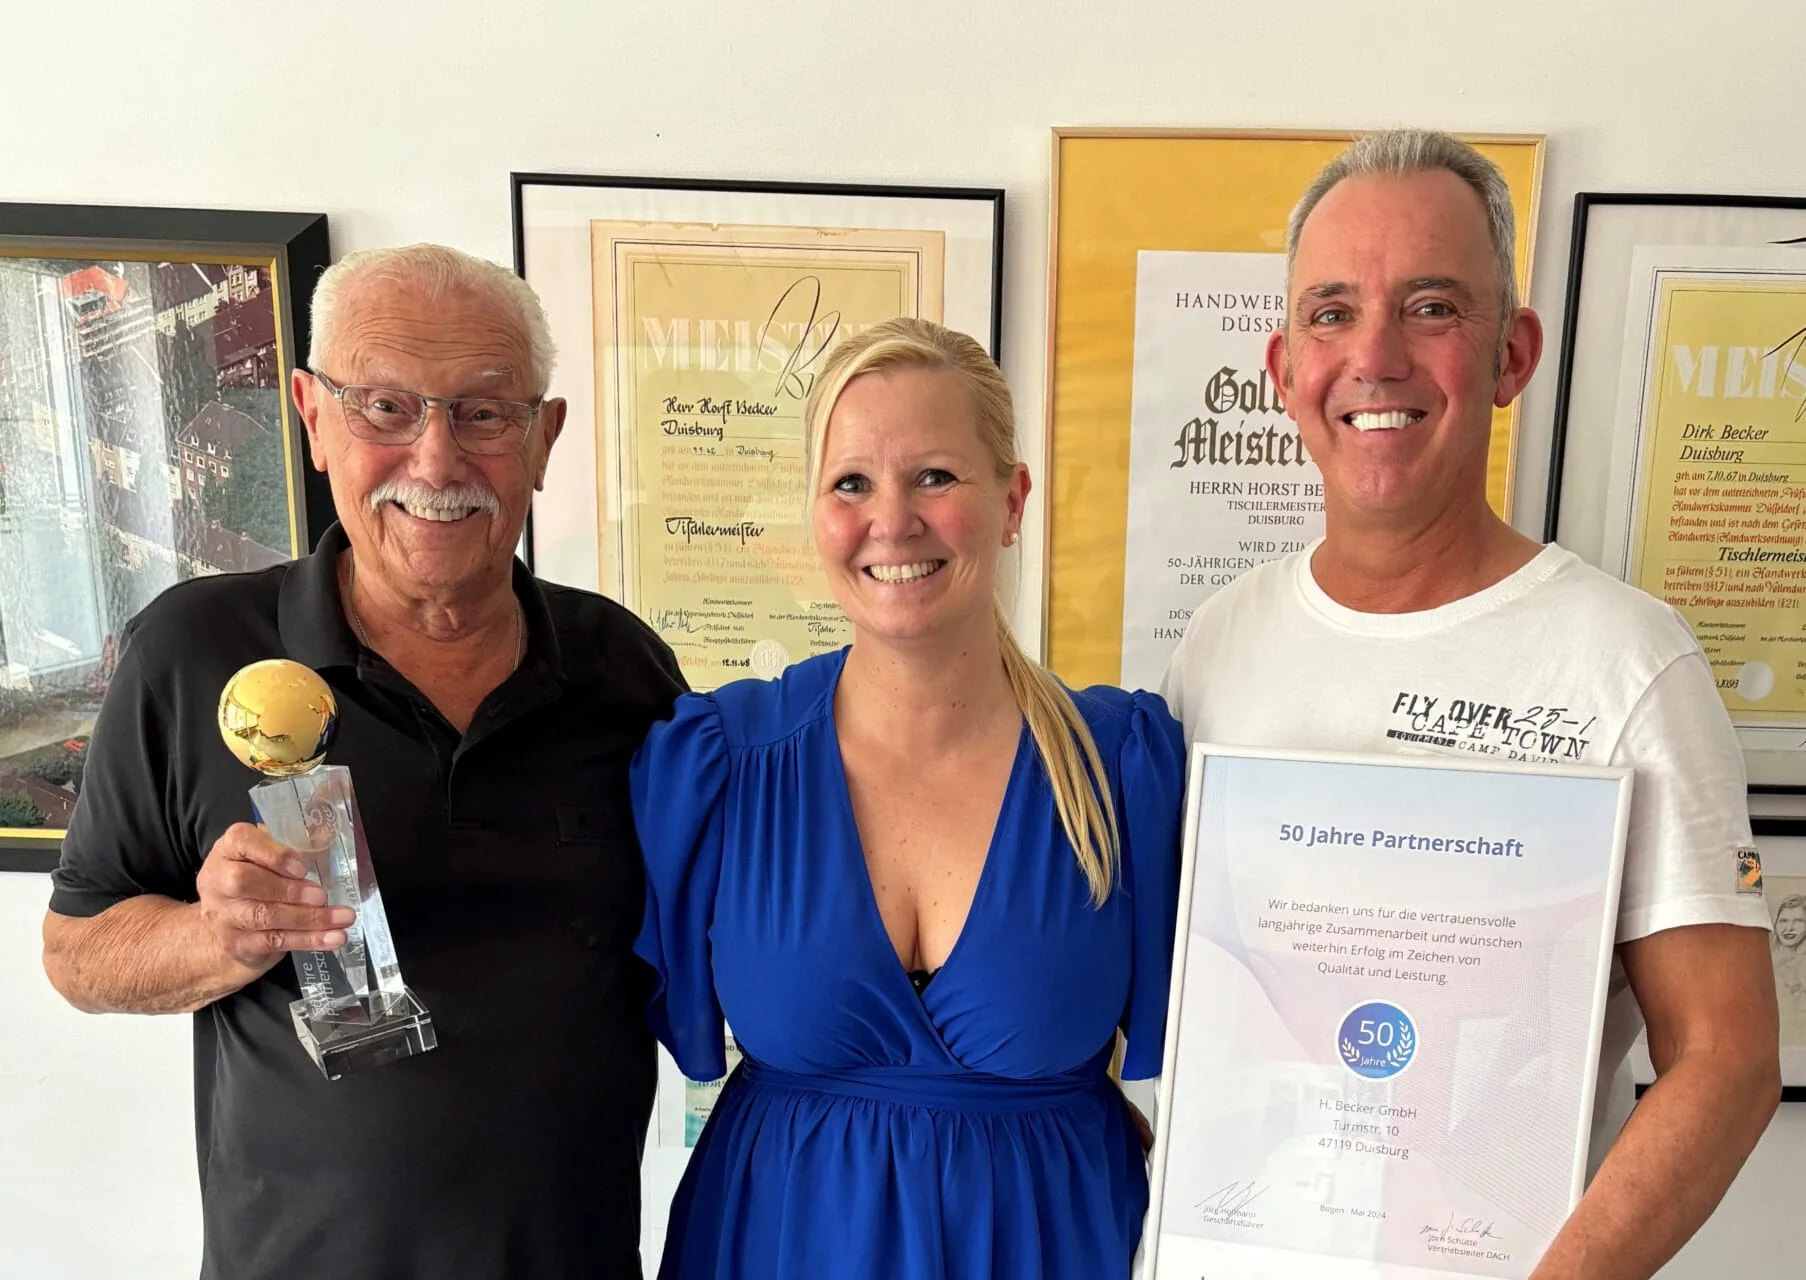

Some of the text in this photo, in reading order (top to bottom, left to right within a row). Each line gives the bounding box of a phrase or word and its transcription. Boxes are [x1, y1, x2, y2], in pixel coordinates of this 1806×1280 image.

[1176, 293, 1285, 310] HANDWER
[1222, 315, 1285, 332] DÜSSE
[641, 316, 858, 375] MEISTE
[1669, 344, 1806, 400] MEIS
[1682, 423, 1769, 441] Dirk Becker
[1170, 417, 1307, 470] Meister
[1680, 445, 1745, 464] Duisburg
[1748, 471, 1790, 483] Duisburg
[1190, 481, 1324, 497] HERRN HORST BE
[1248, 514, 1305, 526] DUISBURG
[1239, 541, 1276, 553] WIRD
[1718, 547, 1806, 562] Tischlermeis
[1167, 556, 1254, 569] 50-JÄHRIGEN
[1180, 574, 1237, 586] DER GO
[1736, 569, 1750, 578] ein
[1169, 608, 1195, 620] DÜS
[1154, 628, 1187, 639] HAN
[1392, 692, 1438, 718] FLY
[1449, 700, 1513, 731] OVER
[1458, 741, 1500, 755] CAMP
[1501, 726, 1590, 761] TOWN
[1279, 824, 1524, 857] 50 Jahre Partnerschaft
[1268, 898, 1288, 910] Wir
[1292, 900, 1349, 915] bedanken
[1353, 908, 1374, 917] uns
[1399, 908, 1417, 920] die
[1420, 911, 1517, 928] vertrauensvolle
[1326, 923, 1429, 941] Zusammenarbeit
[1432, 933, 1455, 943] und
[1459, 935, 1522, 949] wünschen
[1292, 941, 1481, 965] weiterhin Erfolg im Zeichen von
[1317, 961, 1449, 986] Qualität und Leistung.
[1358, 1020, 1394, 1047] 50
[1319, 1098, 1417, 1119] H. Becker GmbH
[1333, 1120, 1399, 1137] Turmstr. 10
[1318, 1138, 1409, 1160] 47119 Duisburg
[1319, 1204, 1345, 1215] Bogen
[1367, 1210, 1387, 1219] 2024
[1427, 1244, 1510, 1261] Vertriebsleiter DACH
